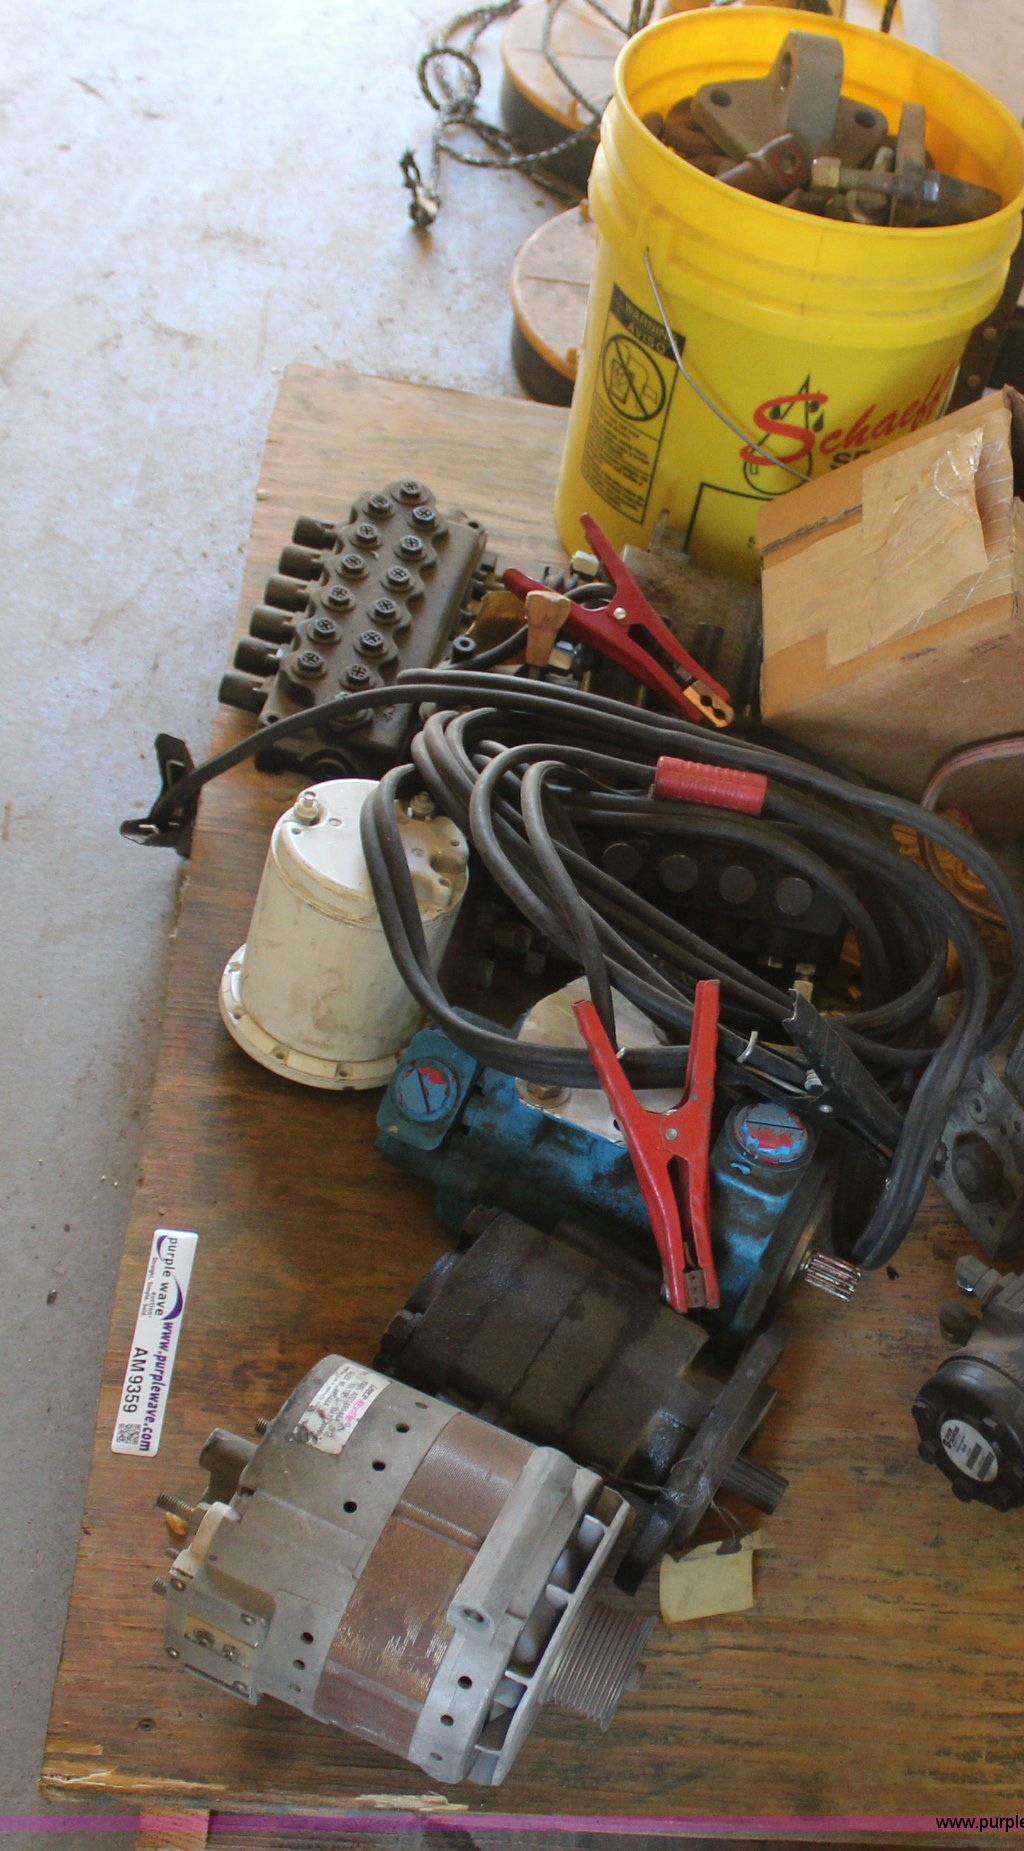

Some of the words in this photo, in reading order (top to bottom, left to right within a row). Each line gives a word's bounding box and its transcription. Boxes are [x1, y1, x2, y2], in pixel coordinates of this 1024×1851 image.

[162, 1236, 178, 1278] purple
[155, 1282, 168, 1316] wave
[139, 1322, 174, 1451] www.purplewave.com
